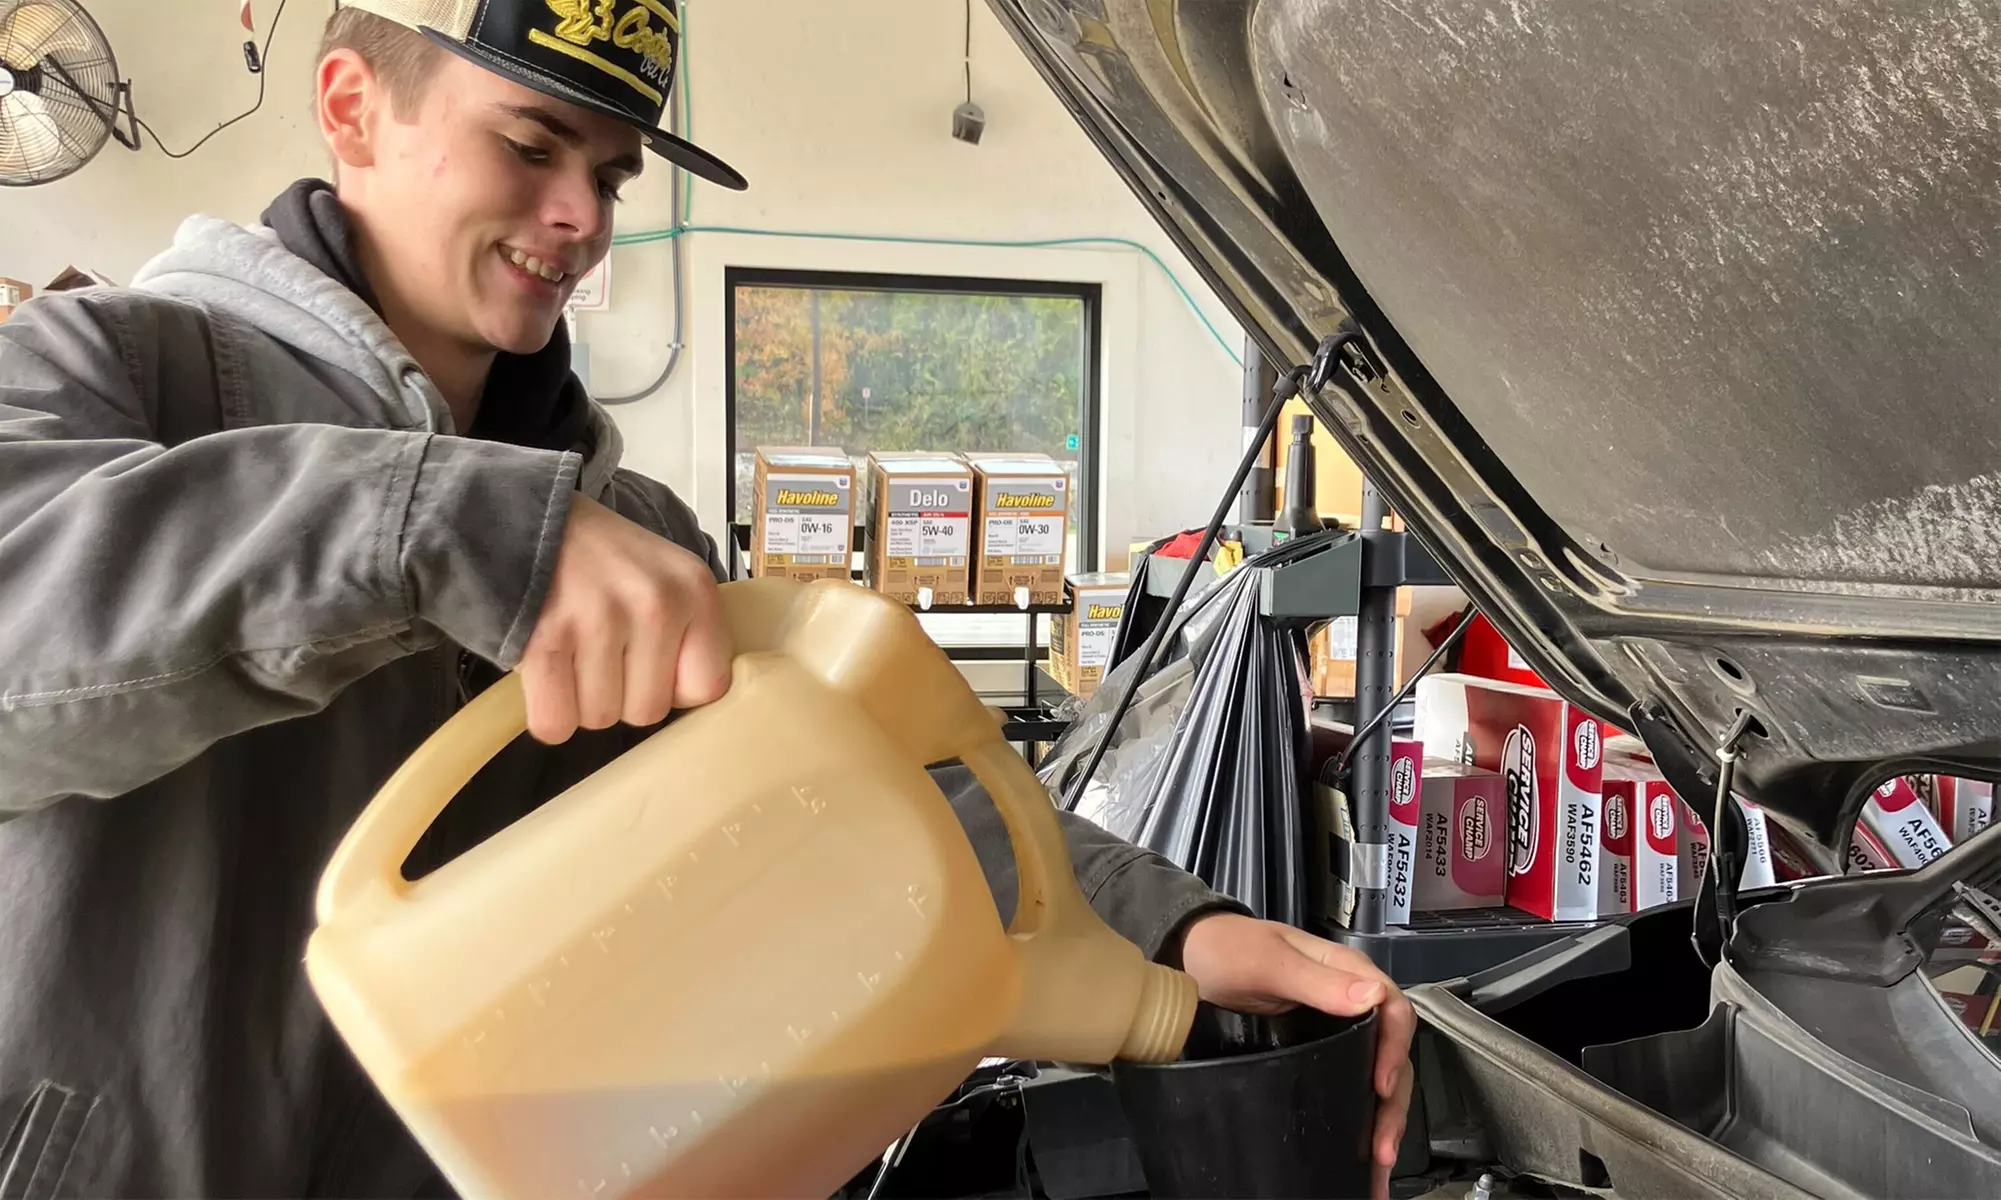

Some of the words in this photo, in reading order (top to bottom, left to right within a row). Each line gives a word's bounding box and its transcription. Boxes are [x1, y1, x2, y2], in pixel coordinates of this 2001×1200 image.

[776, 488, 839, 506] Havoline
[909, 489, 949, 507] Delo
[995, 492, 1055, 508] Havoline
[801, 523, 832, 533] 0W-16
[922, 526, 953, 536] 5W-40
[1019, 524, 1049, 535] 0W-30
[1395, 772, 1404, 803] CHAMP
[1403, 758, 1413, 796] SERVICE
[1519, 735, 1532, 848] SERVICE
[1425, 813, 1433, 860] WAF2014
[1465, 818, 1475, 860] CHAMP
[1475, 799, 1485, 848] SERVICE
[1566, 803, 1577, 864] WAF3590
[1435, 813, 1447, 877] AF5433
[1578, 804, 1594, 886] AF5462
[1393, 834, 1410, 908] AF5432
